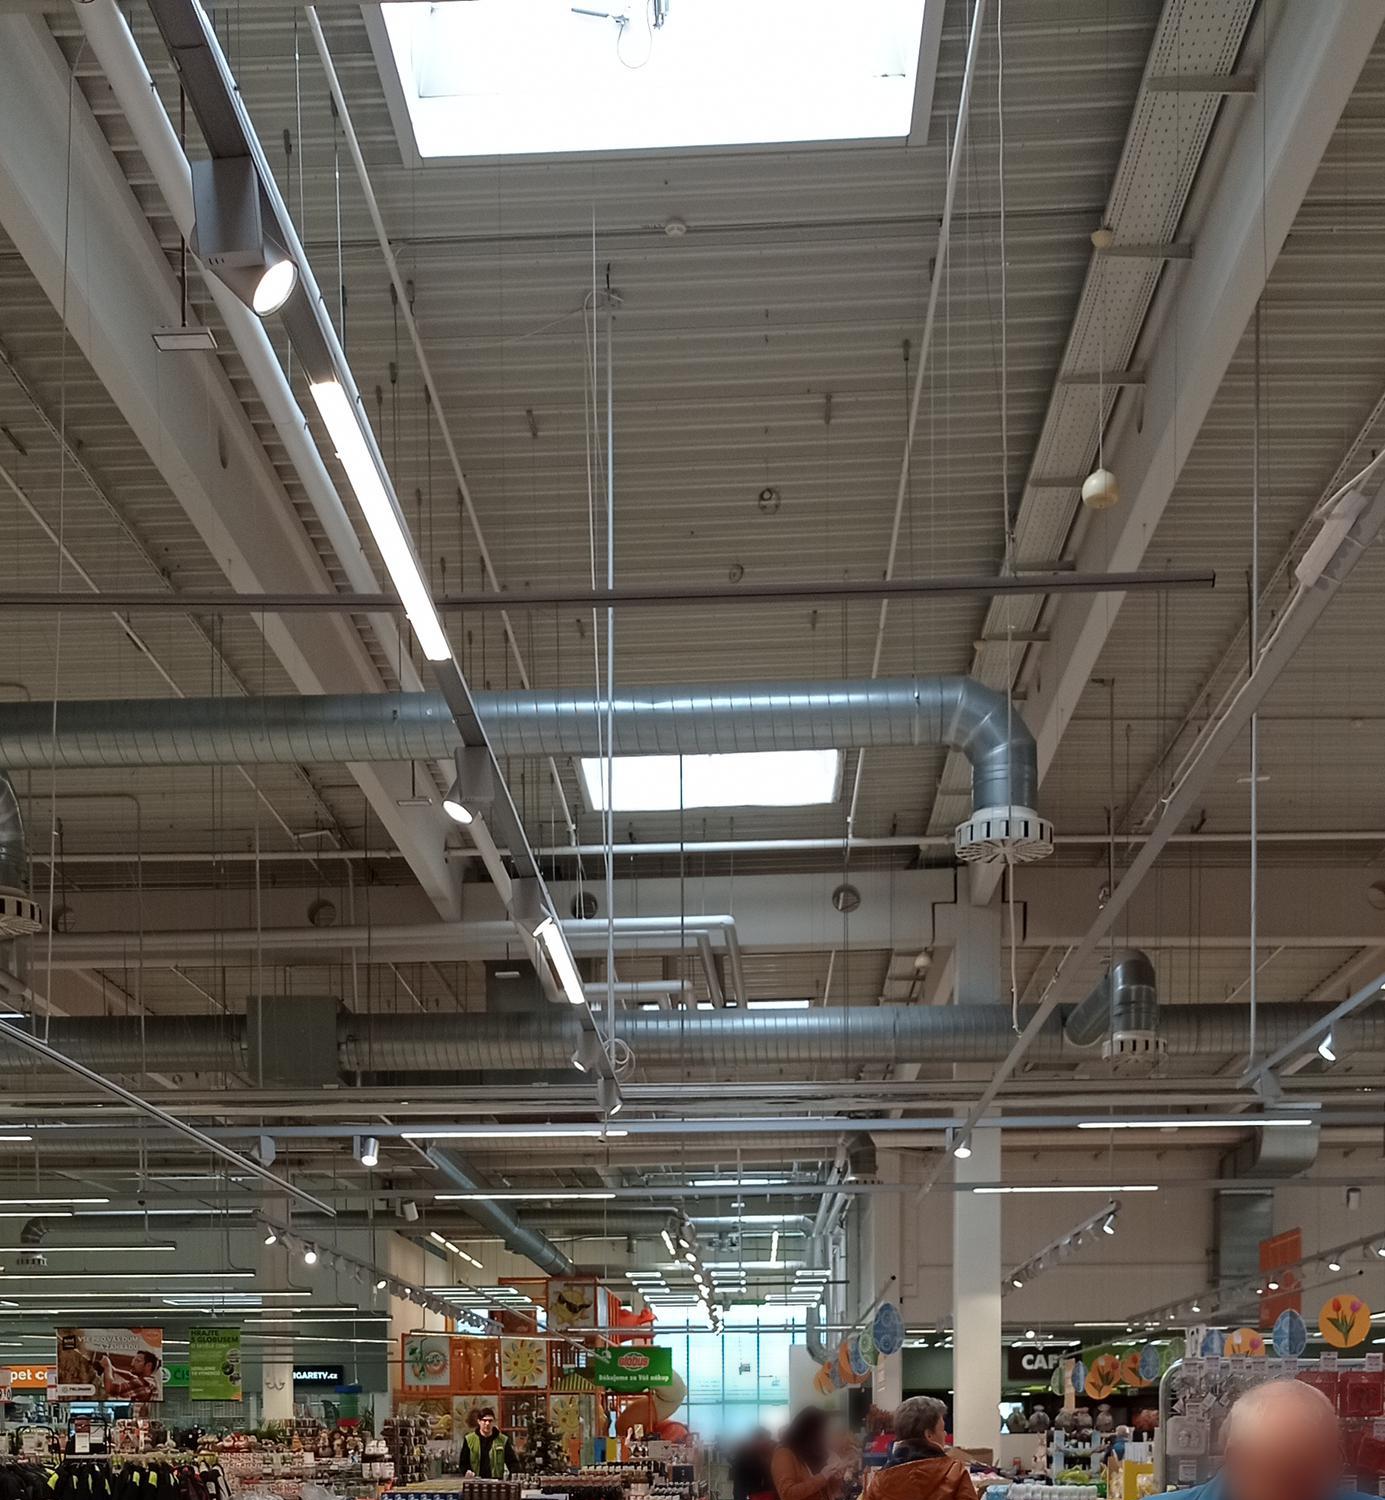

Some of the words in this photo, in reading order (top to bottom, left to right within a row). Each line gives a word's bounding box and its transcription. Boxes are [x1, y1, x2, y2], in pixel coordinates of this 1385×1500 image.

[197, 1336, 239, 1344] GLOBUSEM
[1022, 1353, 1060, 1370] CAF
[10, 1369, 32, 1383] pet
[293, 1371, 338, 1379] IGARETY.cz
